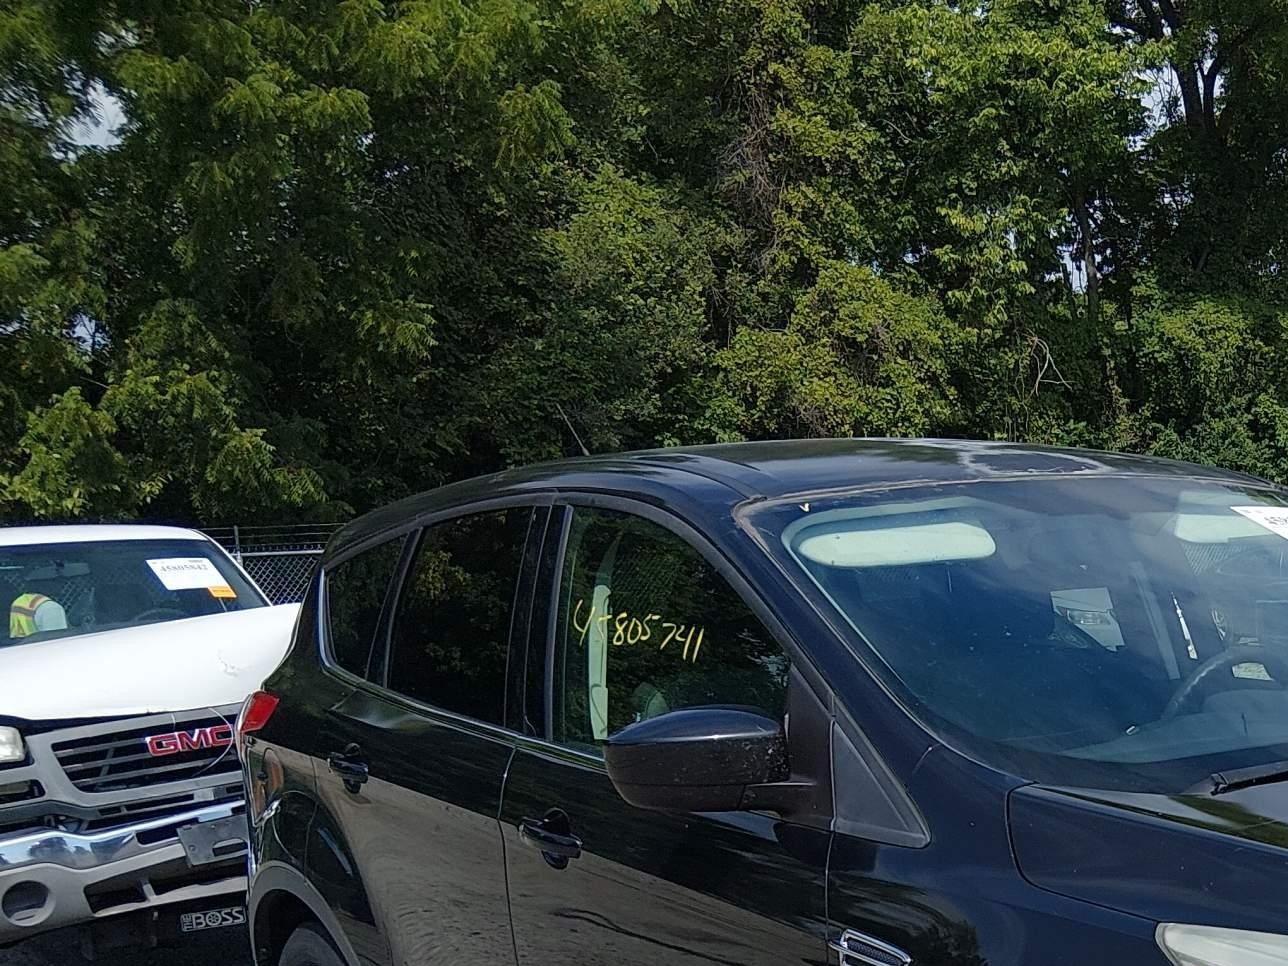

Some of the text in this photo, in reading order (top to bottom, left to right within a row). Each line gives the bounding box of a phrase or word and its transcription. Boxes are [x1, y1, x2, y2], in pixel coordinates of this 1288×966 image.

[573, 599, 705, 663] 45805741
[145, 724, 234, 757] GMC
[192, 906, 245, 929] BOSS
